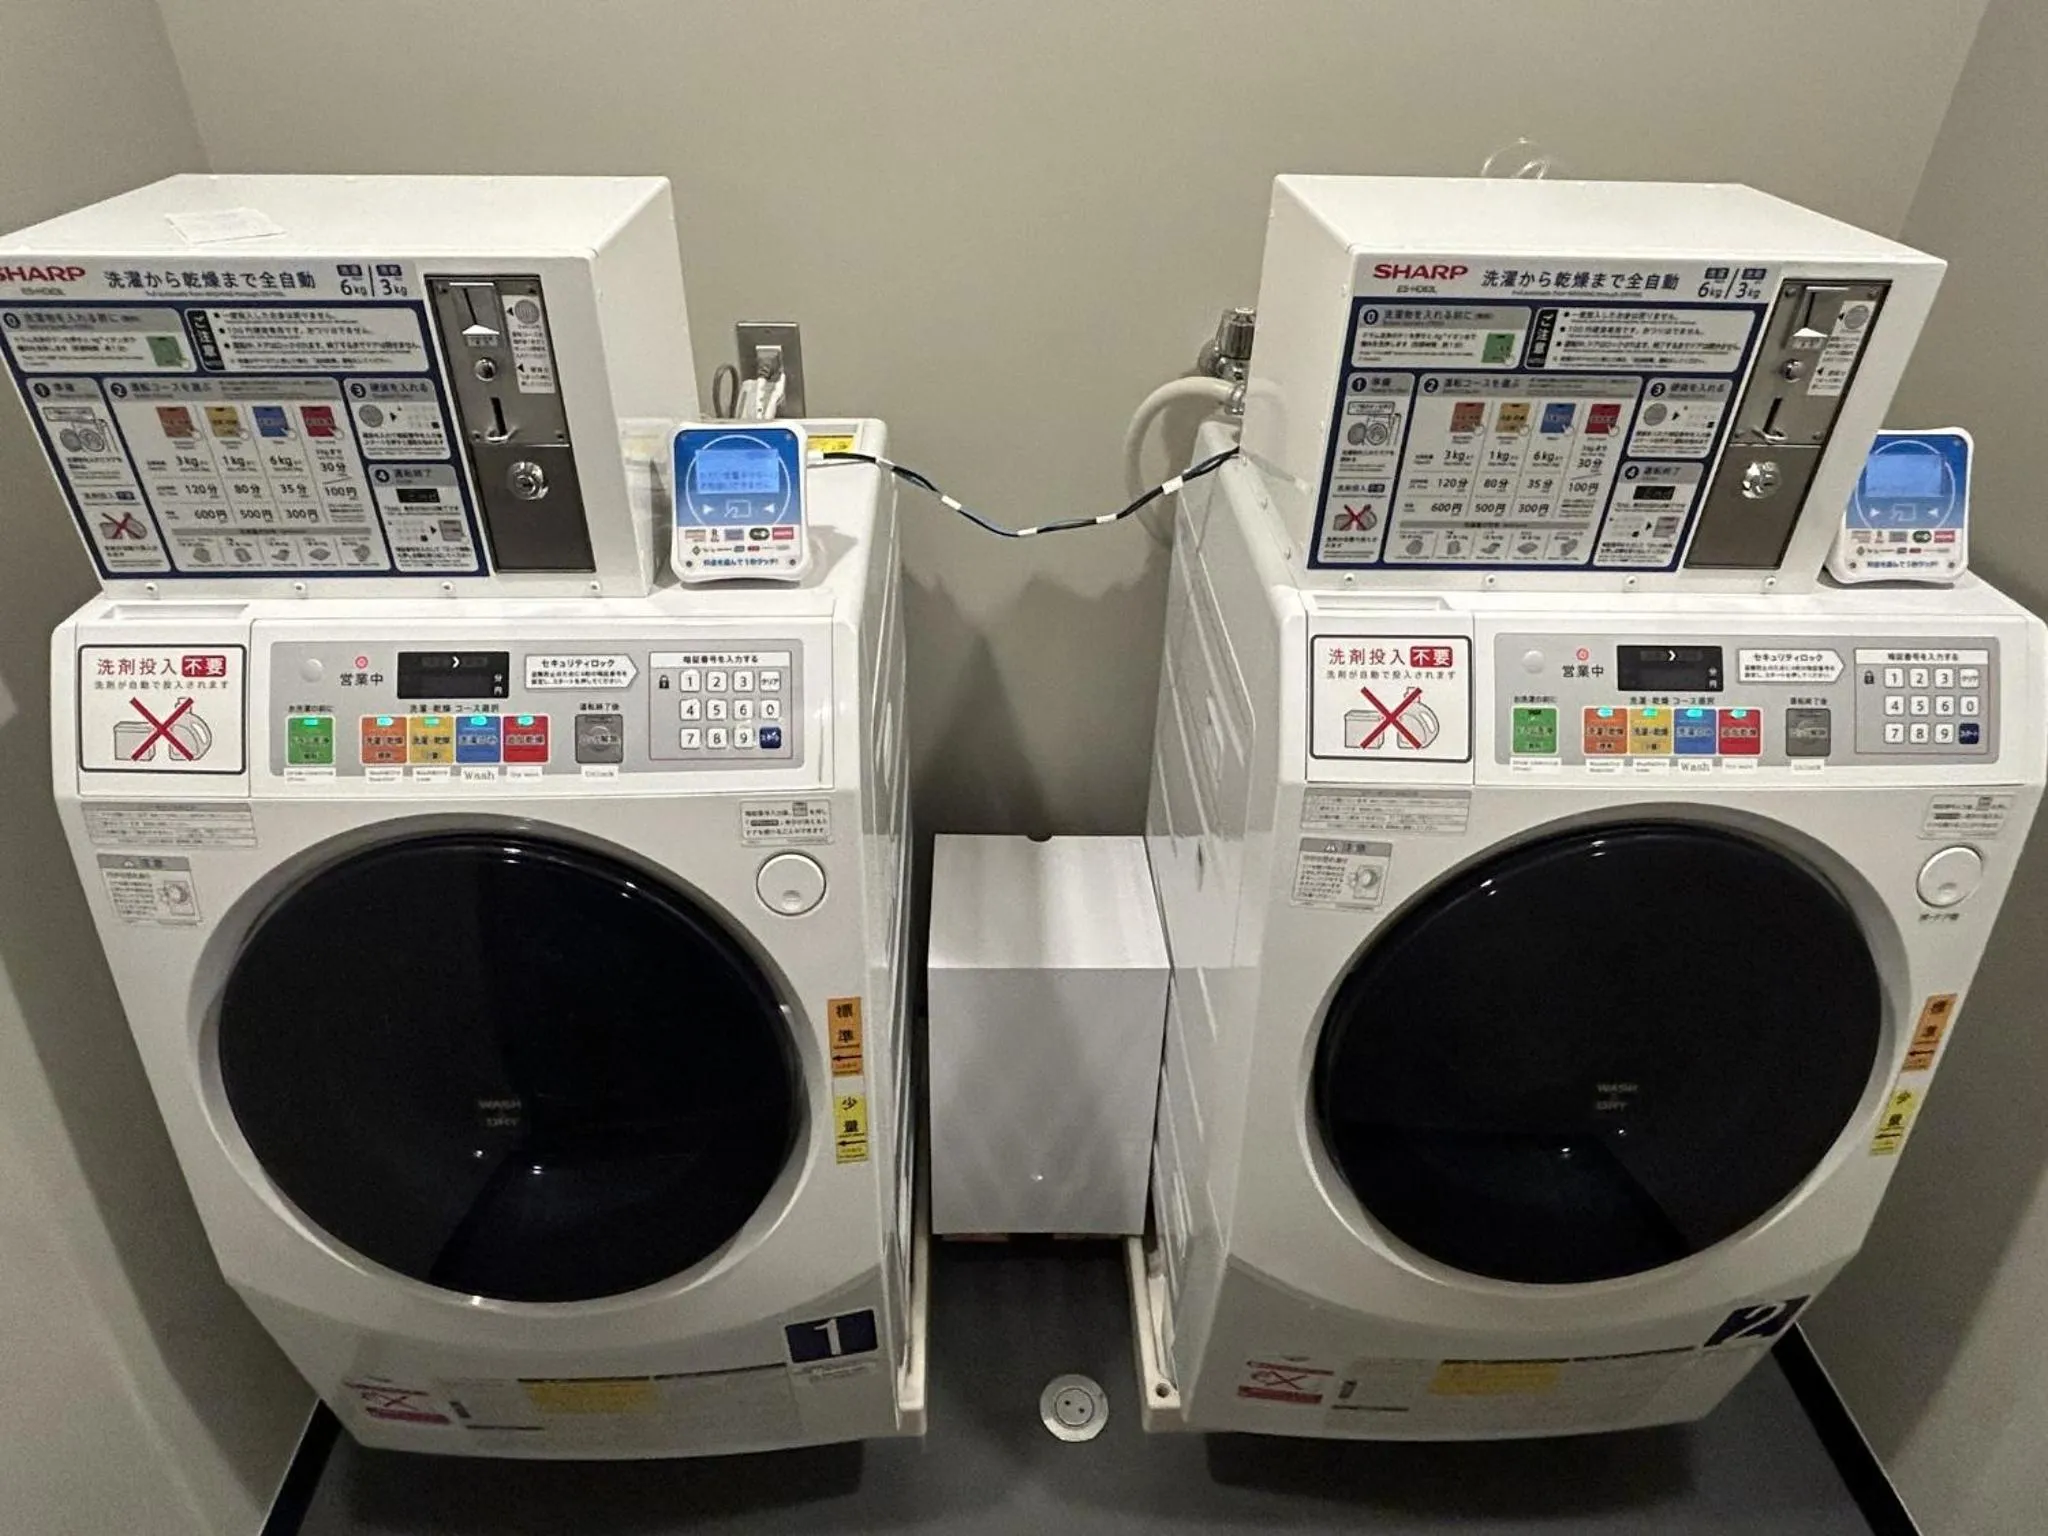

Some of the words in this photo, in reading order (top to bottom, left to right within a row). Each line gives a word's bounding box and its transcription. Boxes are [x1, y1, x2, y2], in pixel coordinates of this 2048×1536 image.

[0, 265, 86, 286] HARP
[1373, 263, 1468, 284] SHARP
[104, 270, 316, 291] 洗濯から乾燥まで全自動
[1480, 270, 1680, 291] 洗濯から乾燥まで全自動
[683, 655, 759, 664] 暗証番号を入力する
[1328, 648, 1405, 666] 洗剤投入
[1413, 648, 1451, 667] 不要
[1754, 653, 1823, 662] セキュリティロック
[1888, 652, 1959, 661] 暗証番号を入力する
[96, 658, 177, 676] 洗剤投入
[184, 657, 225, 676] 不要
[541, 659, 616, 668] セキュリティロック
[1326, 670, 1456, 680] 洗剤が自動で投入されます
[1562, 664, 1604, 678] 営業中
[339, 672, 384, 687] 営業中
[686, 677, 693, 687] 1
[713, 677, 721, 687] 2
[740, 677, 748, 687] 3
[1891, 673, 1898, 683] 1
[1916, 673, 1924, 683] 2
[1941, 673, 1949, 683] 3
[94, 680, 229, 690] 洗剤が自動で投入されます
[686, 705, 694, 715] 4
[713, 705, 721, 715] 5
[740, 705, 748, 715] 6
[766, 705, 774, 715] 0
[1891, 701, 1899, 711] 4
[1917, 701, 1924, 711] 5
[1942, 701, 1949, 711] 6
[1966, 701, 1974, 711] 0
[687, 734, 694, 744] 7
[713, 734, 721, 744] 8
[740, 734, 747, 744] 9
[1891, 729, 1899, 739] 7
[1916, 729, 1924, 739] 8
[1941, 729, 1948, 739] 9
[1681, 763, 1709, 773] Wash
[464, 770, 496, 780] Wash
[836, 1003, 854, 1043] 標準
[841, 1096, 859, 1133] 少量
[1719, 1303, 1786, 1343] 2
[814, 1318, 842, 1356] 1
